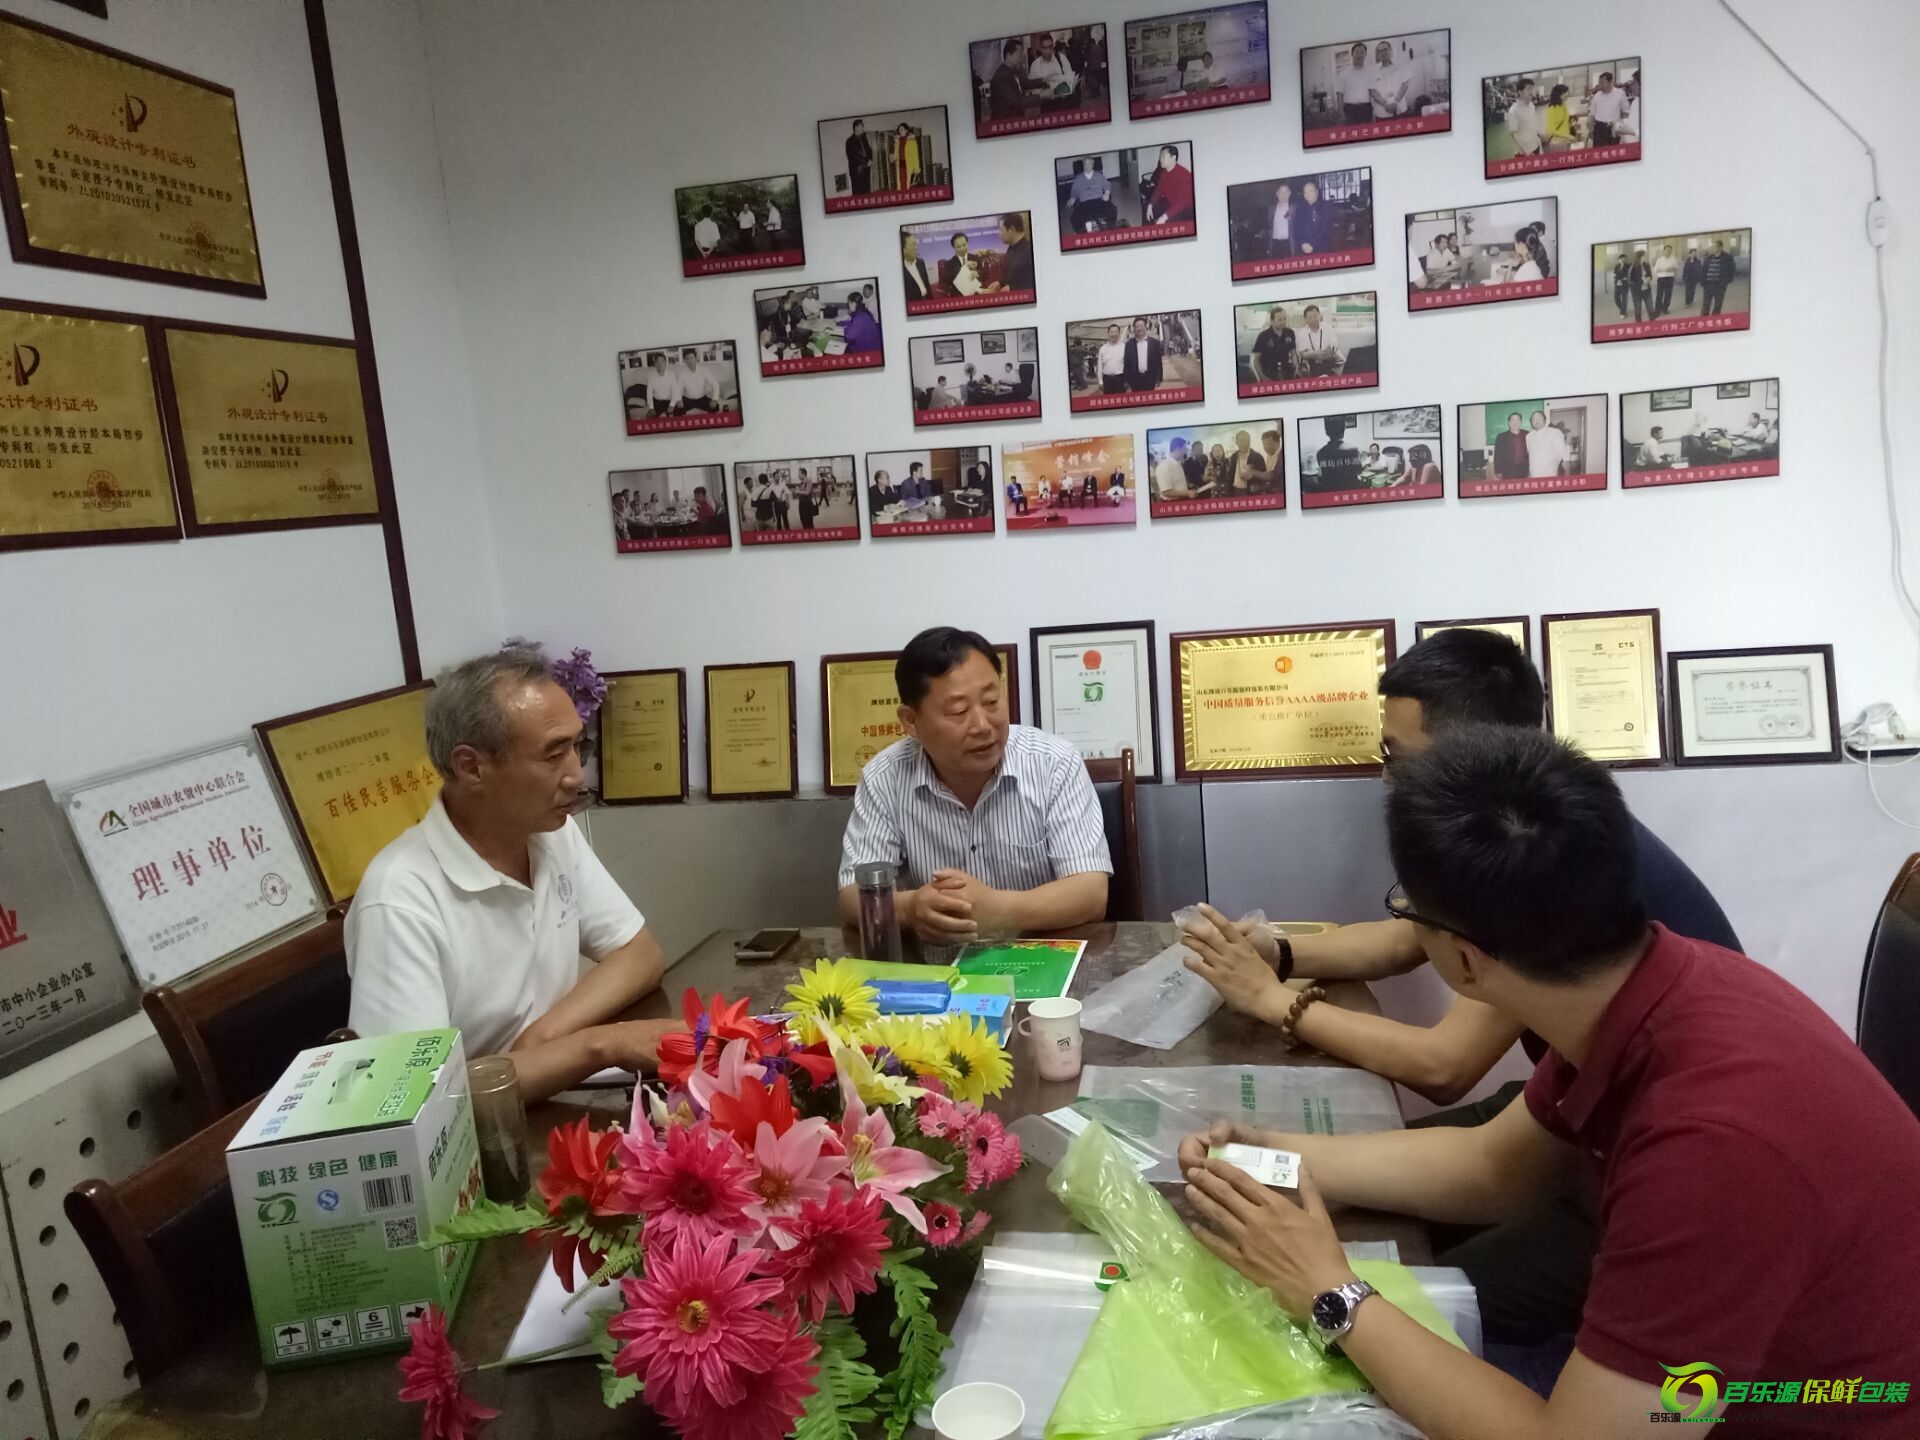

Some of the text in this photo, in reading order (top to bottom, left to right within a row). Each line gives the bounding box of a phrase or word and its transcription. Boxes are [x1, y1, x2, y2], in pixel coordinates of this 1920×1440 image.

[67, 123, 196, 168] 外观设计专利证书
[227, 407, 328, 423] 外观设计专利证书
[1203, 690, 1369, 710] 中国质量服务信誉AAAA级品牌企业
[128, 770, 246, 817] 全国城市农贸中心联合会
[324, 765, 443, 818] 百佳民营服务企
[132, 825, 271, 901] 理事单位
[257, 1150, 400, 1188] 科技 绿色 健康
